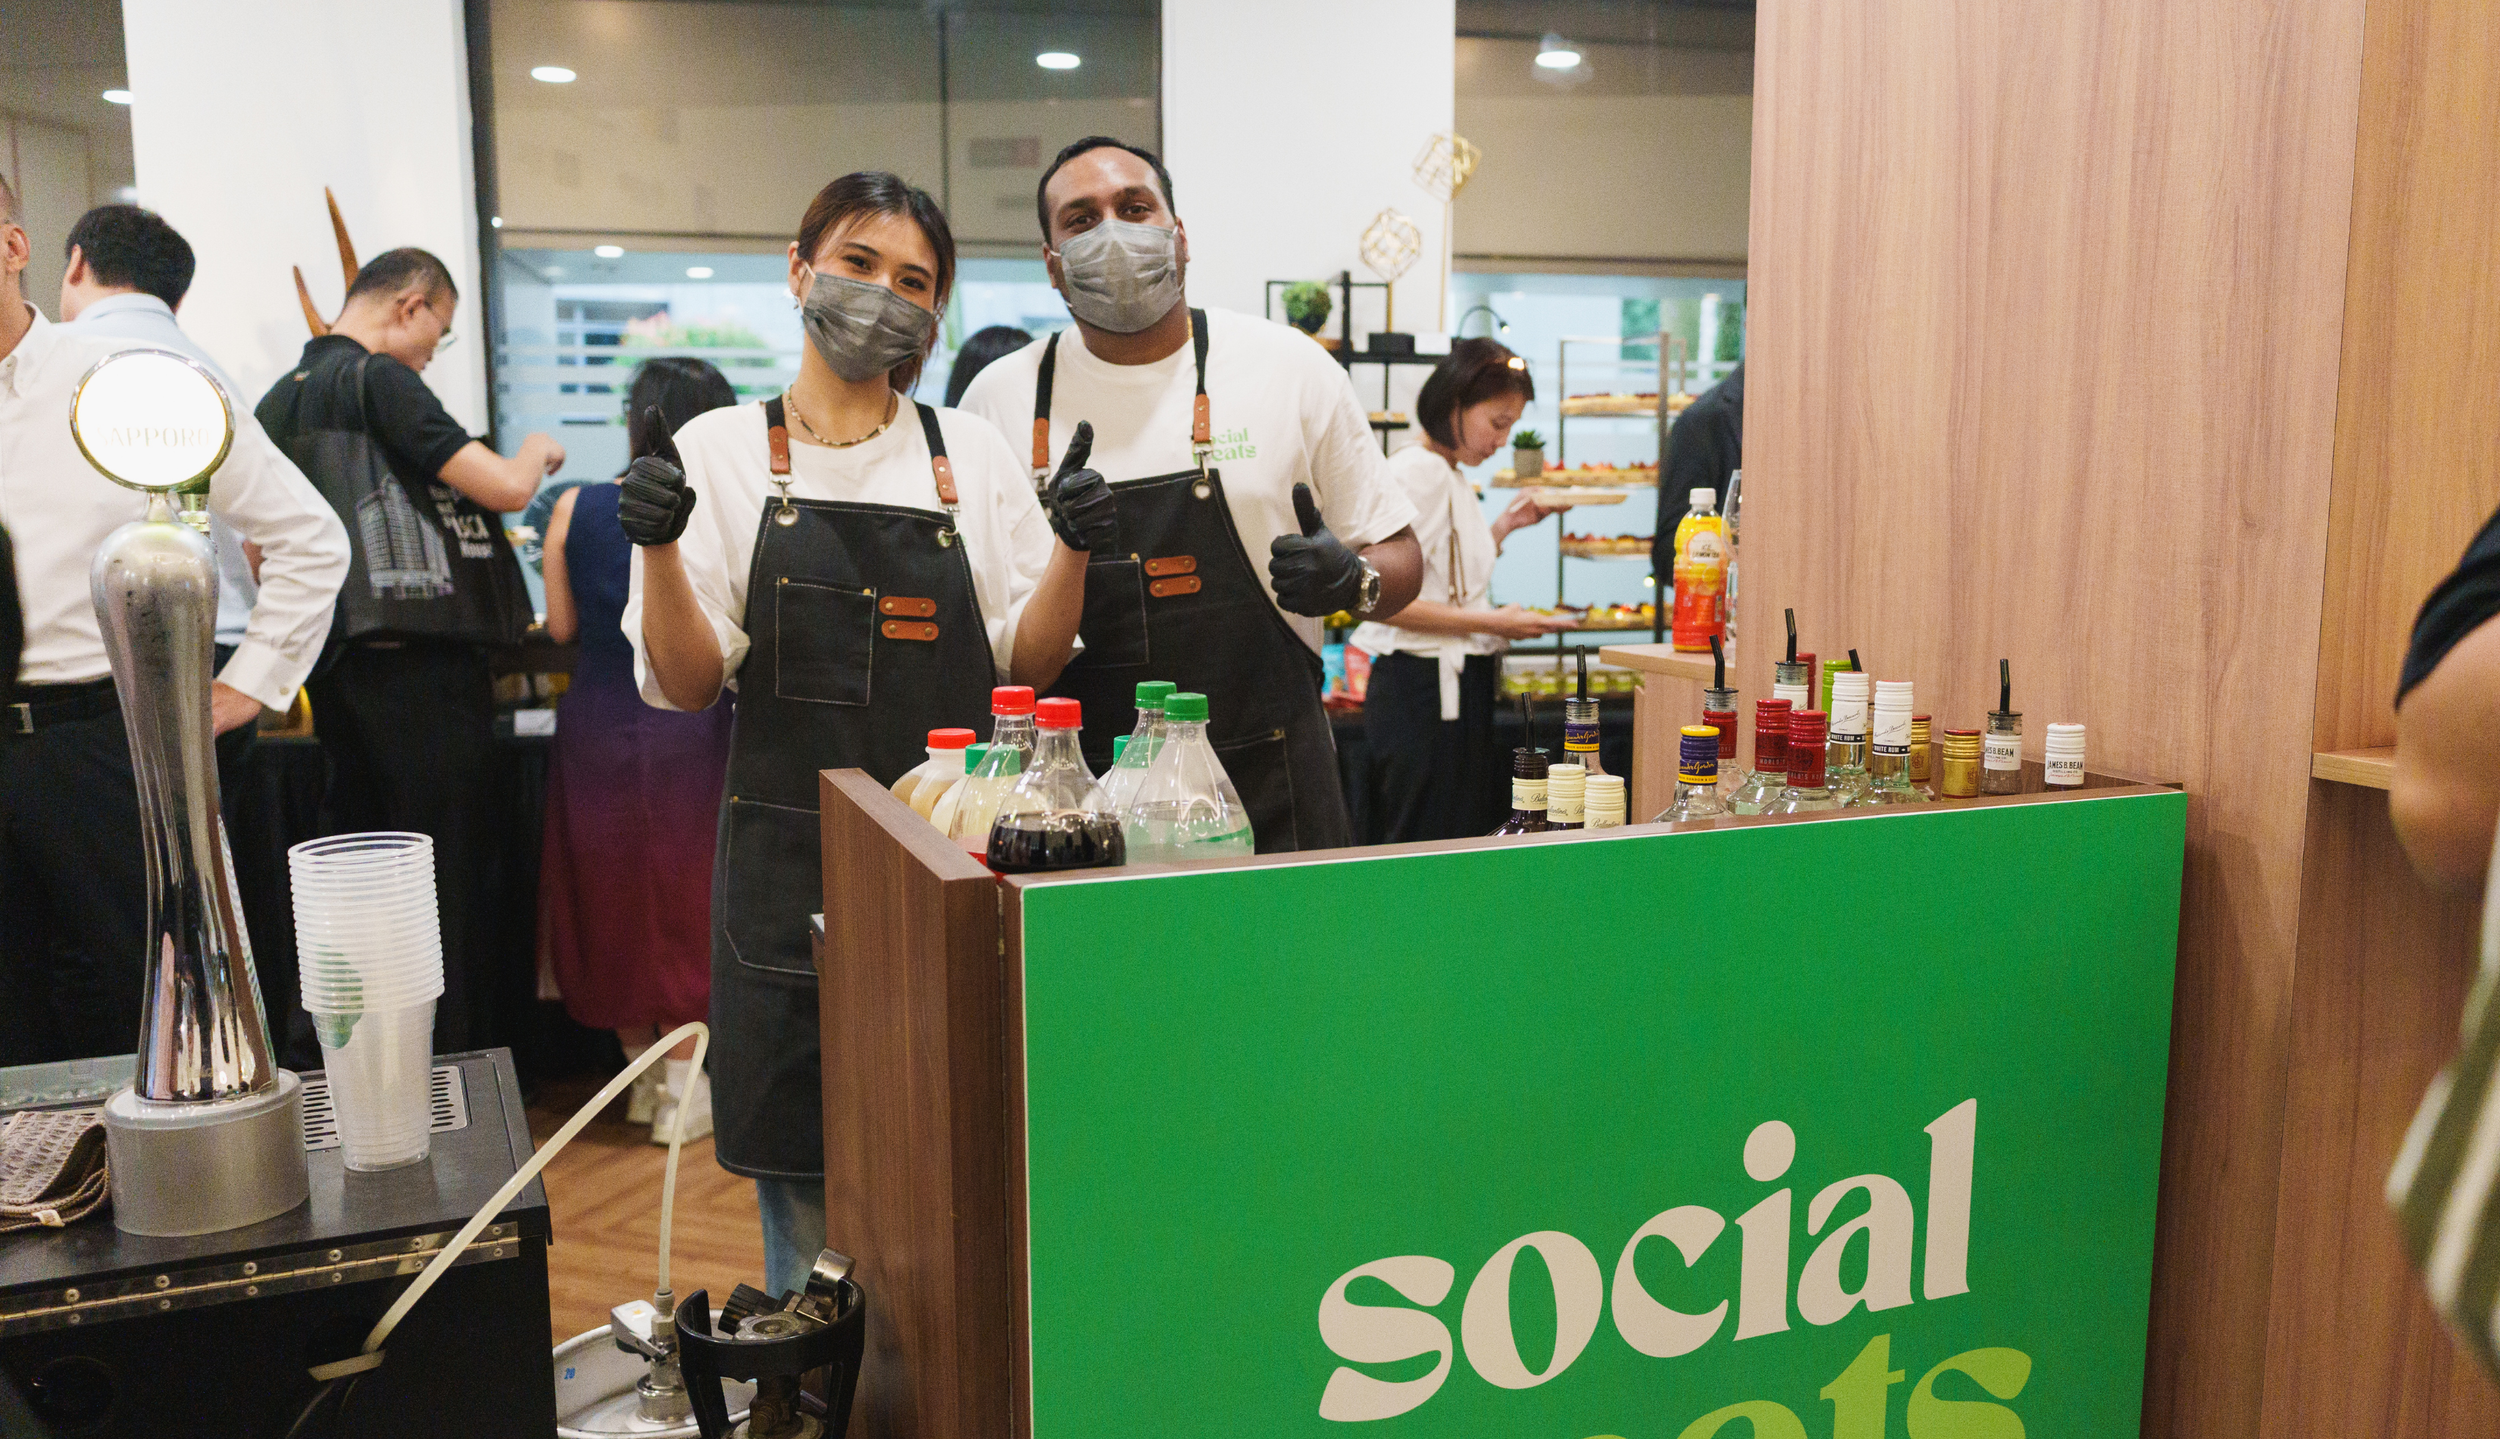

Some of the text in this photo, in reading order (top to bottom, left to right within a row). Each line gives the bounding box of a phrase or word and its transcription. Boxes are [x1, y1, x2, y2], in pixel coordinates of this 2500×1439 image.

[97, 427, 210, 448] SAPPORO
[1210, 443, 1257, 462] eats
[1997, 748, 2014, 757] BEAM
[2047, 760, 2063, 770] JAMES
[2069, 761, 2084, 770] BEAM
[1319, 1098, 1977, 1422] social
